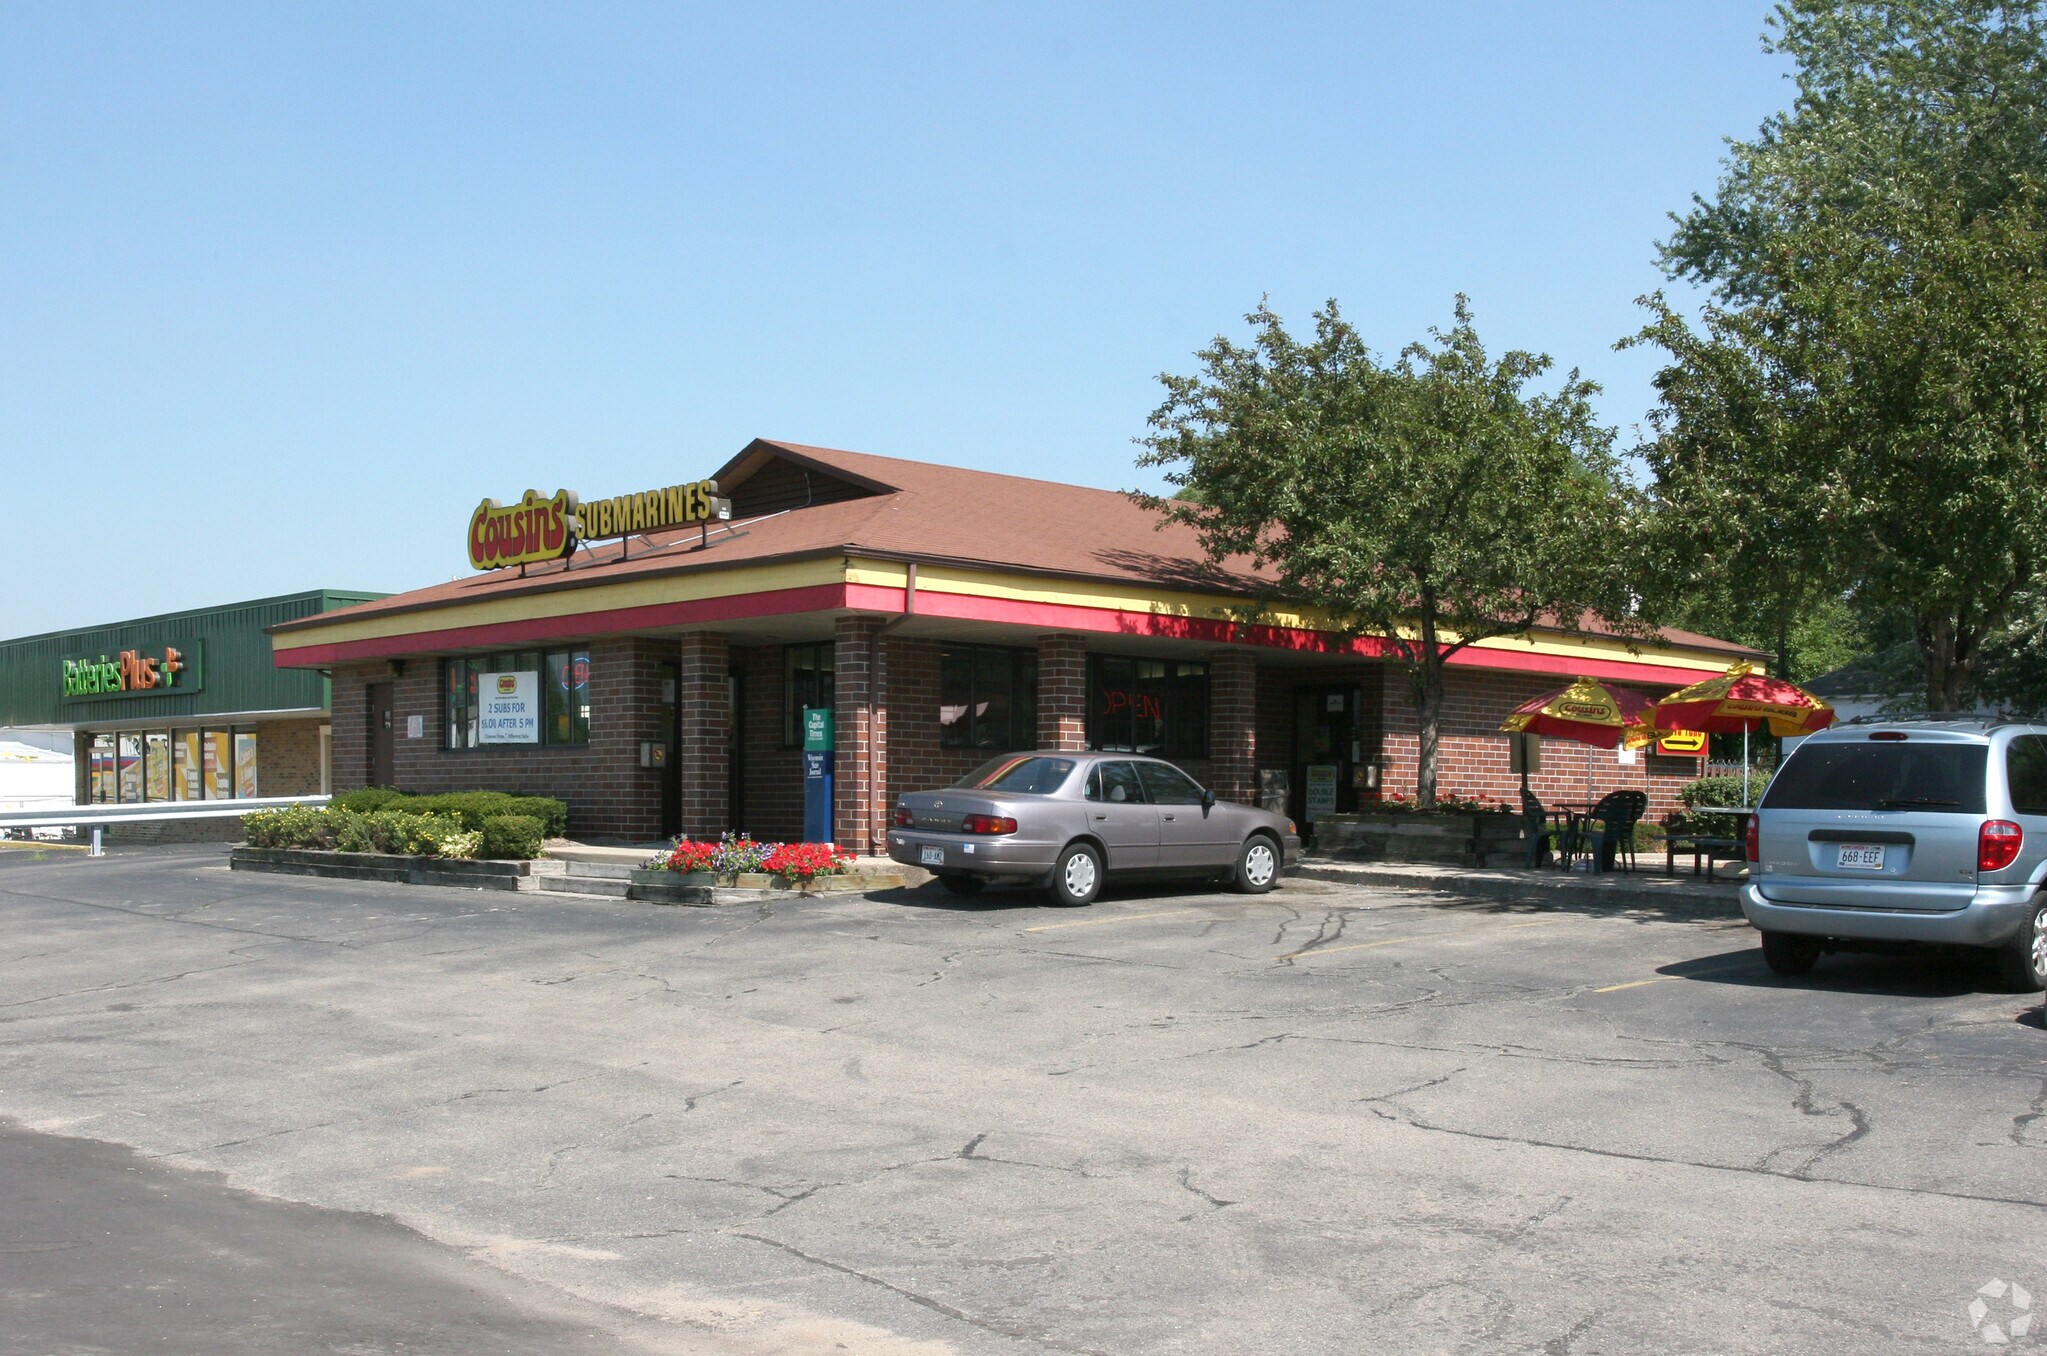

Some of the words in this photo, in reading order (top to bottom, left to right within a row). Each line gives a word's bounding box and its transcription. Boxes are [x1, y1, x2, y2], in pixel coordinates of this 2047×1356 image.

[471, 496, 564, 563] Cousins
[575, 481, 712, 540] SUBMARINES
[488, 703, 493, 713] 2
[494, 703, 511, 713] SUBS
[512, 702, 526, 713] FOR
[1565, 704, 1606, 715] Cousins
[812, 713, 821, 721] The
[498, 718, 517, 729] AFTER
[519, 718, 524, 728] 5
[525, 717, 534, 728] PM
[809, 729, 823, 738] Times
[1307, 788, 1335, 796] DOUBLE
[1307, 796, 1335, 805] STAMPS
[1842, 851, 1880, 863] 668-EEF
